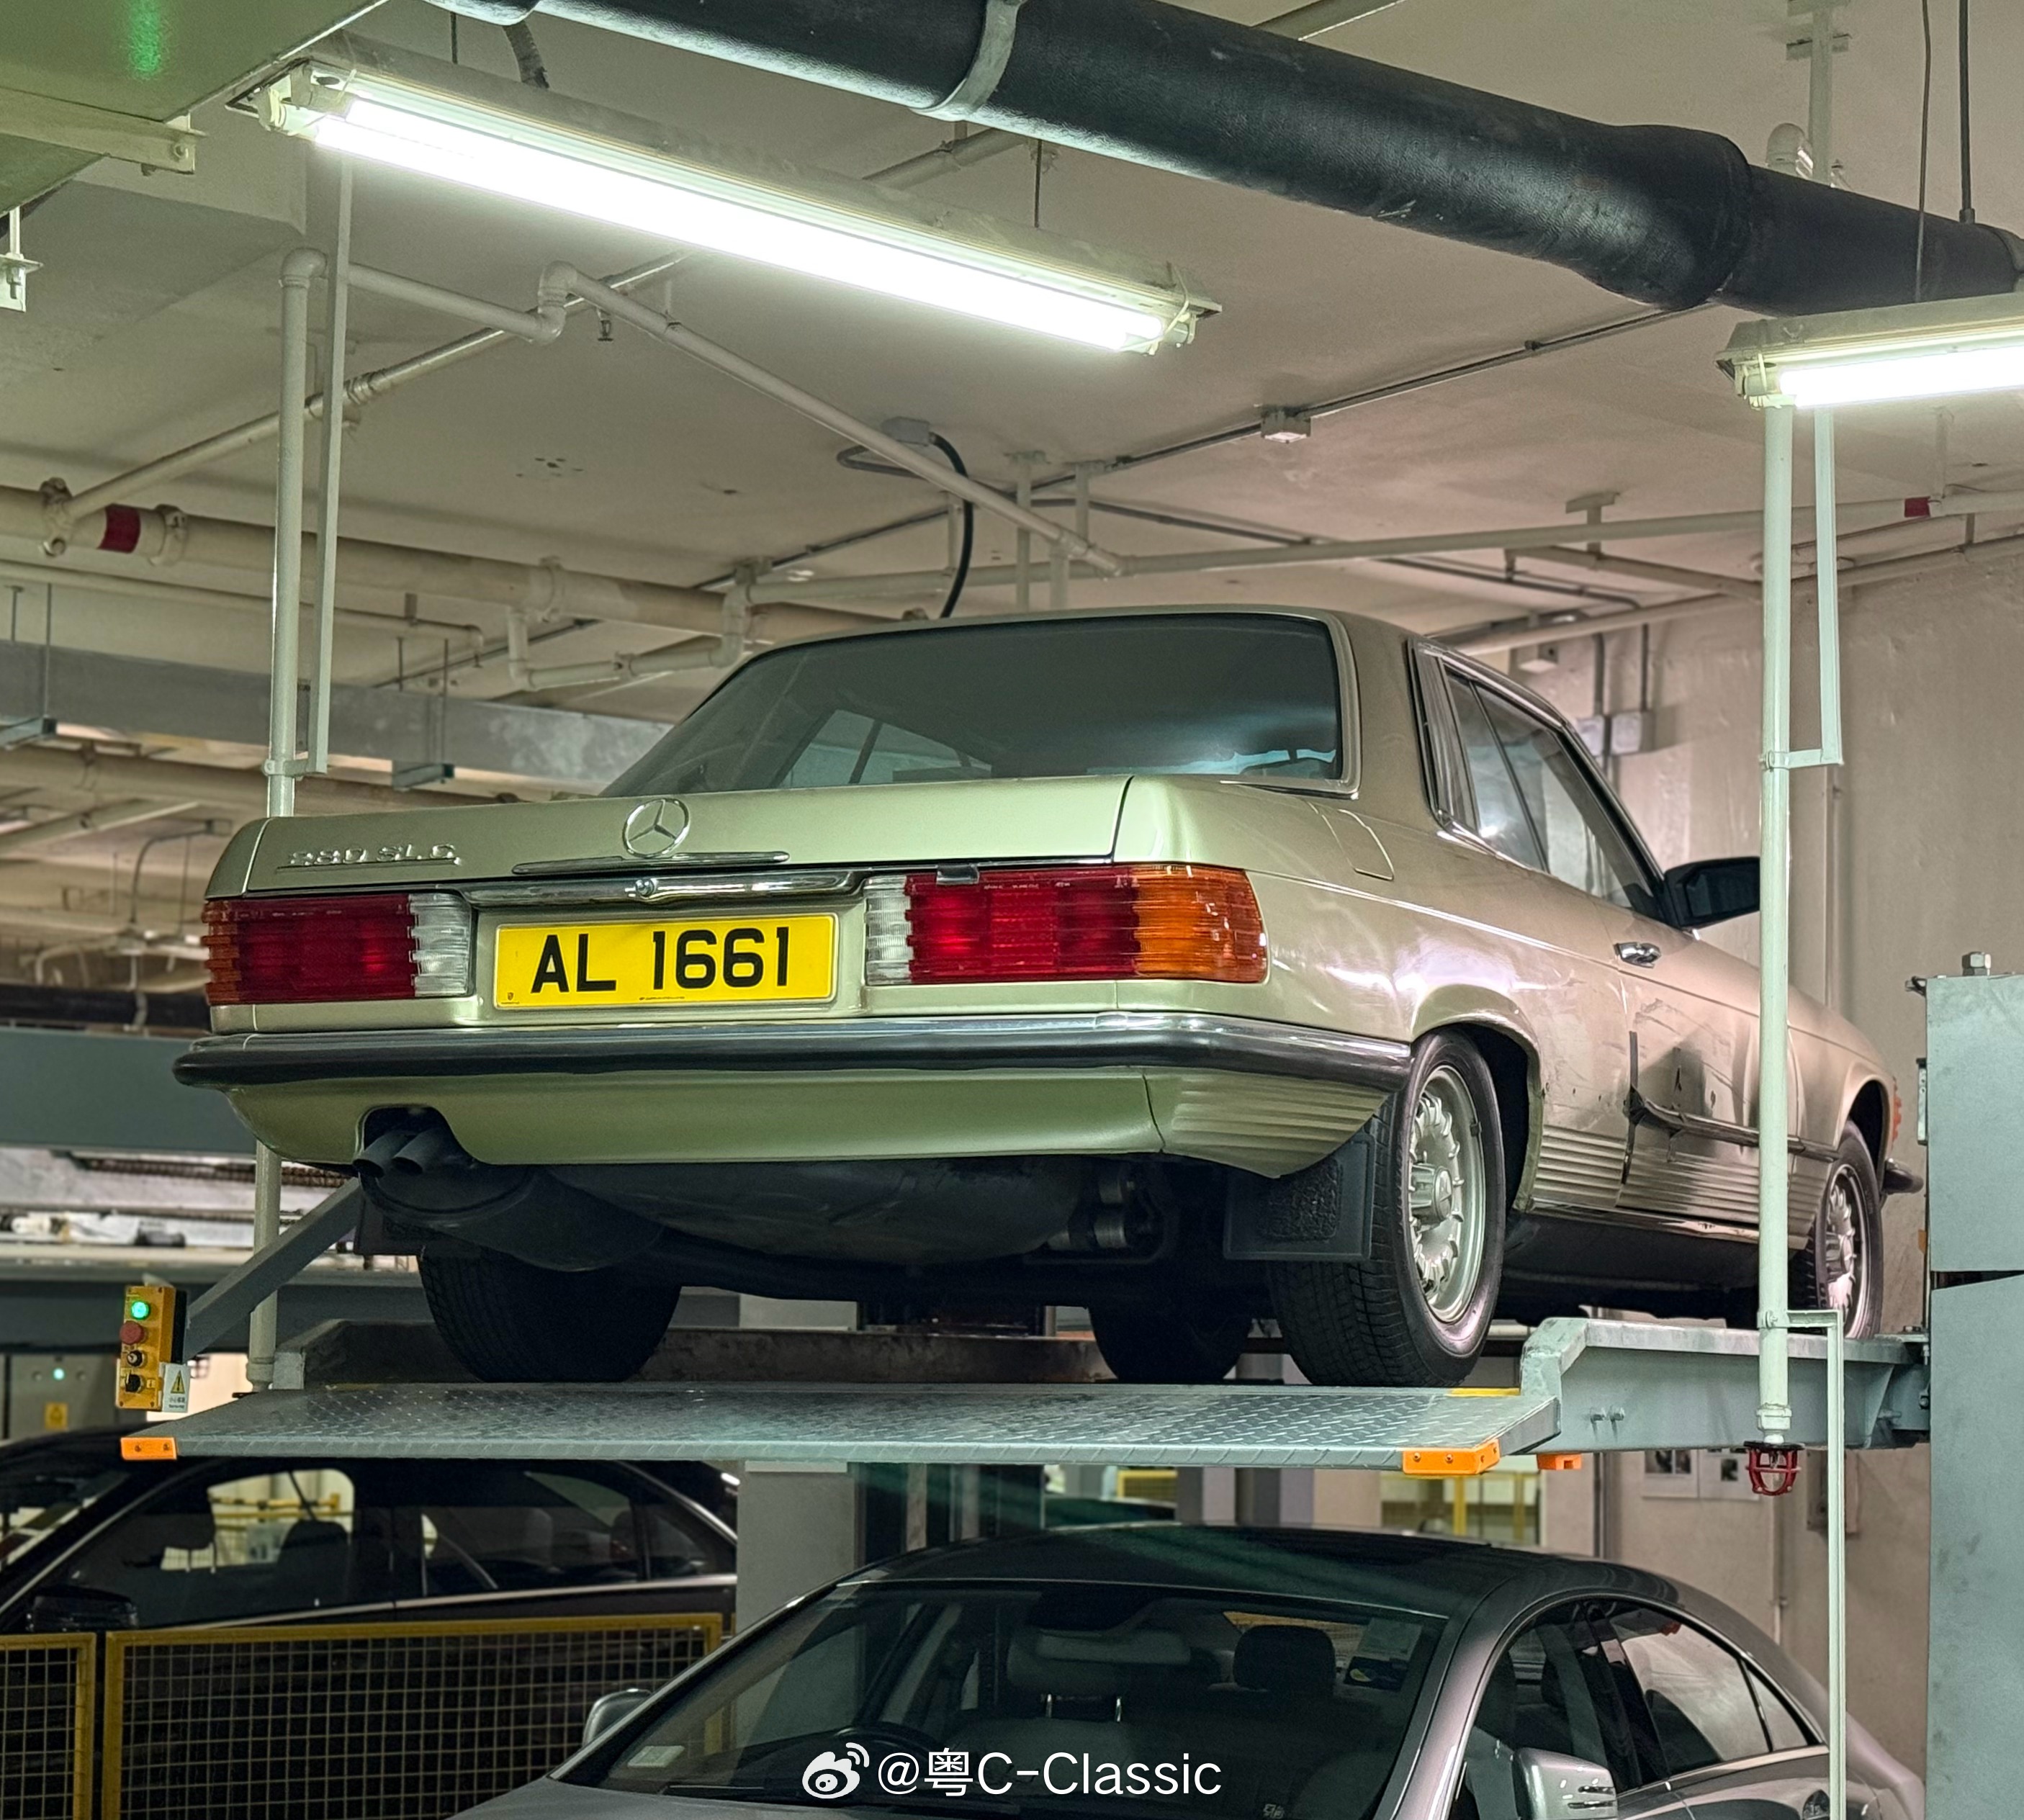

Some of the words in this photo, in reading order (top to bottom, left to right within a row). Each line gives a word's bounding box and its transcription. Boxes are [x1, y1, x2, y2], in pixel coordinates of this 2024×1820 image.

[377, 843, 456, 862] SLC
[531, 934, 617, 994] AL
[652, 927, 789, 990] 1661
